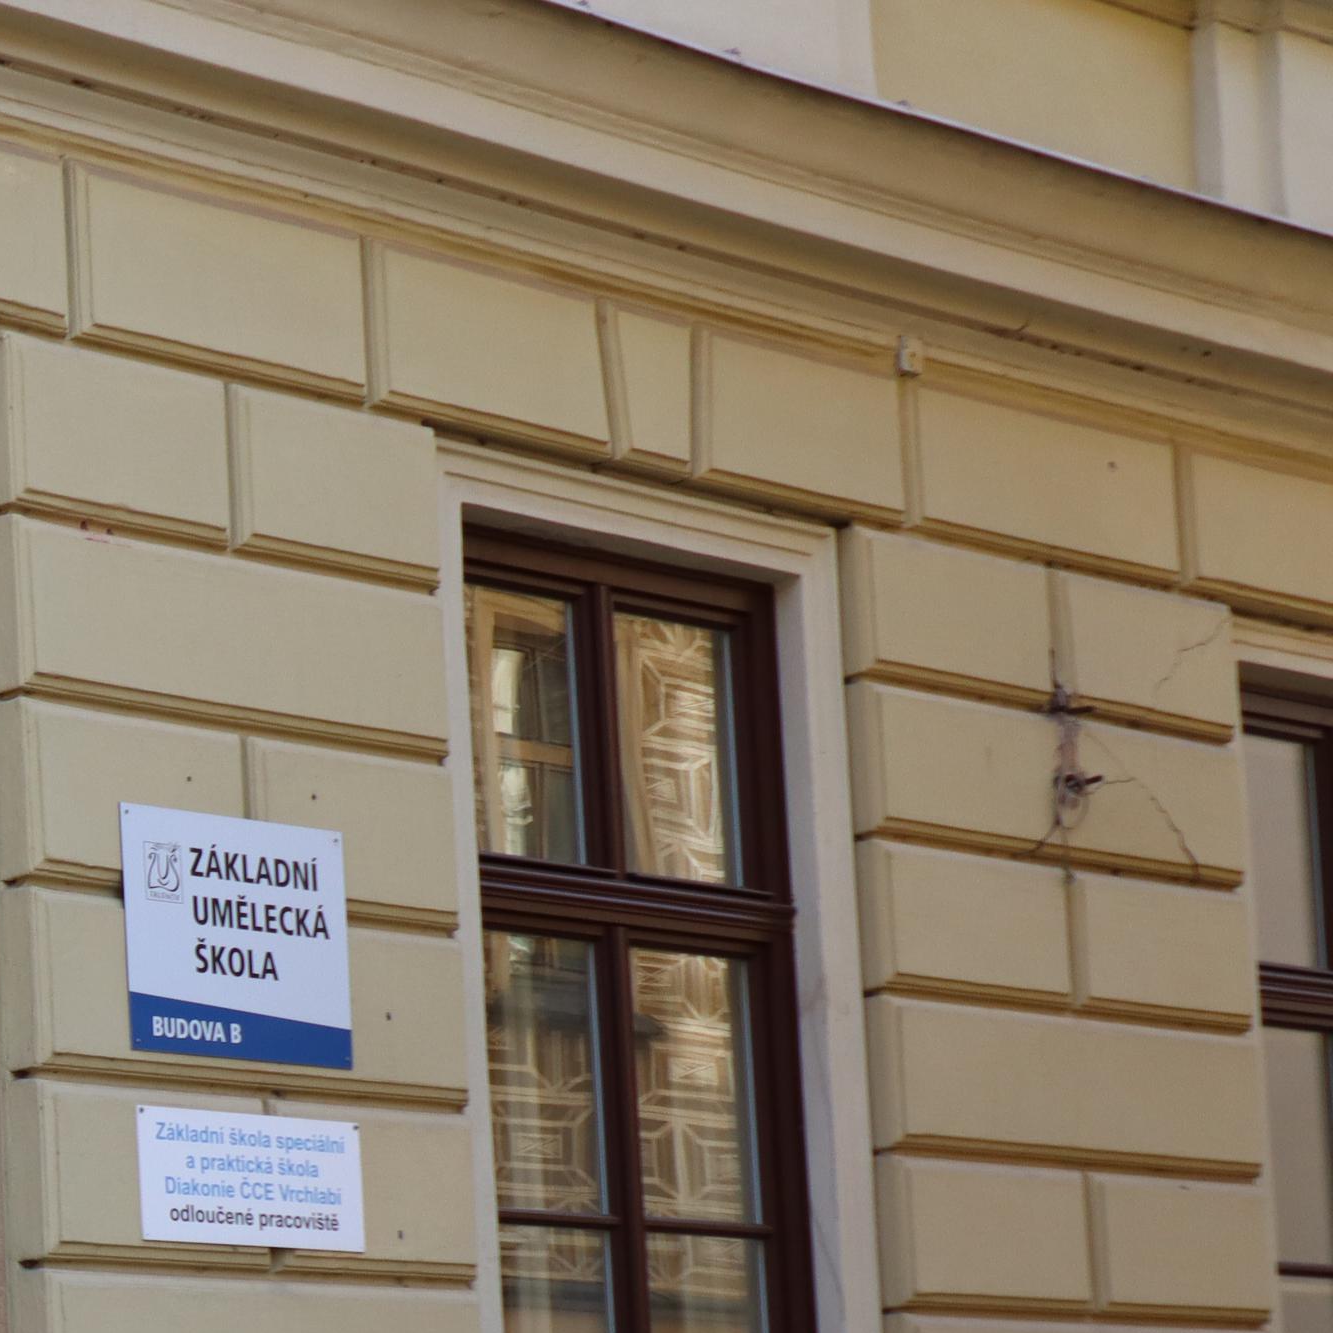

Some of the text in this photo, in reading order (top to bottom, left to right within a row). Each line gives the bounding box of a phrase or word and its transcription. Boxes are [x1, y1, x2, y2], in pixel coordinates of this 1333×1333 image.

[189, 844, 318, 892] ZÁKLADNÍ
[193, 895, 330, 940] UMĚLECKÁ
[195, 937, 279, 981] ŠKOLA
[152, 1016, 242, 1044] BUDOVA B
[155, 1122, 345, 1154] Základní škola speciální
[186, 1154, 319, 1178] a praktická škola
[165, 1176, 342, 1205] Diakonie ČCE Vrchlabí
[170, 1204, 339, 1232] odloučené pracoviště
